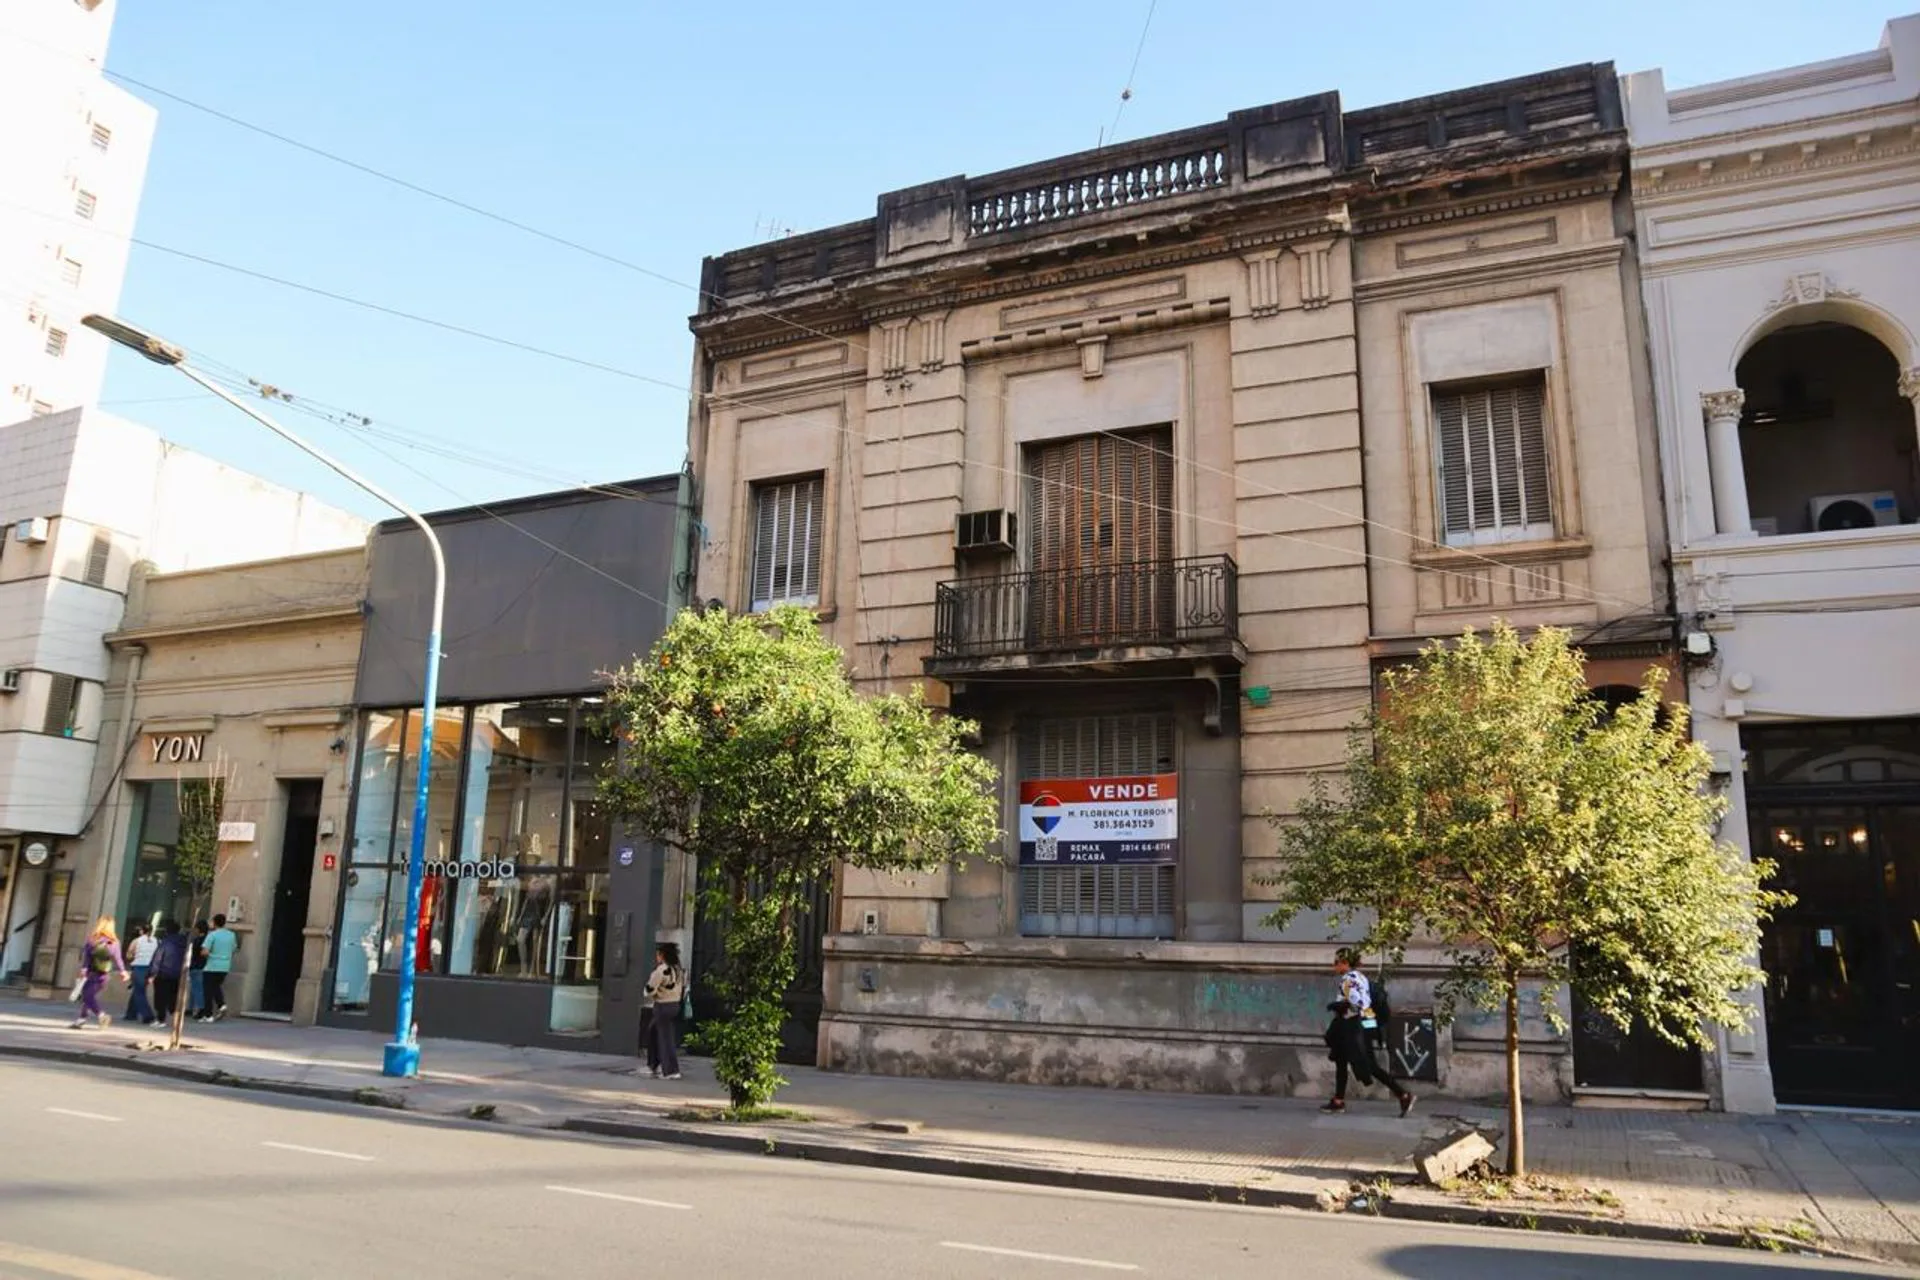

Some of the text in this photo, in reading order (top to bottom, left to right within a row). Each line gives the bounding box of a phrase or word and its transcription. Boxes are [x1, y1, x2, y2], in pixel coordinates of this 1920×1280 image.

[152, 736, 204, 761] YON
[1089, 784, 1158, 799] VENDE
[1080, 809, 1129, 818] FLORENCIA
[400, 853, 515, 878] tmanola
